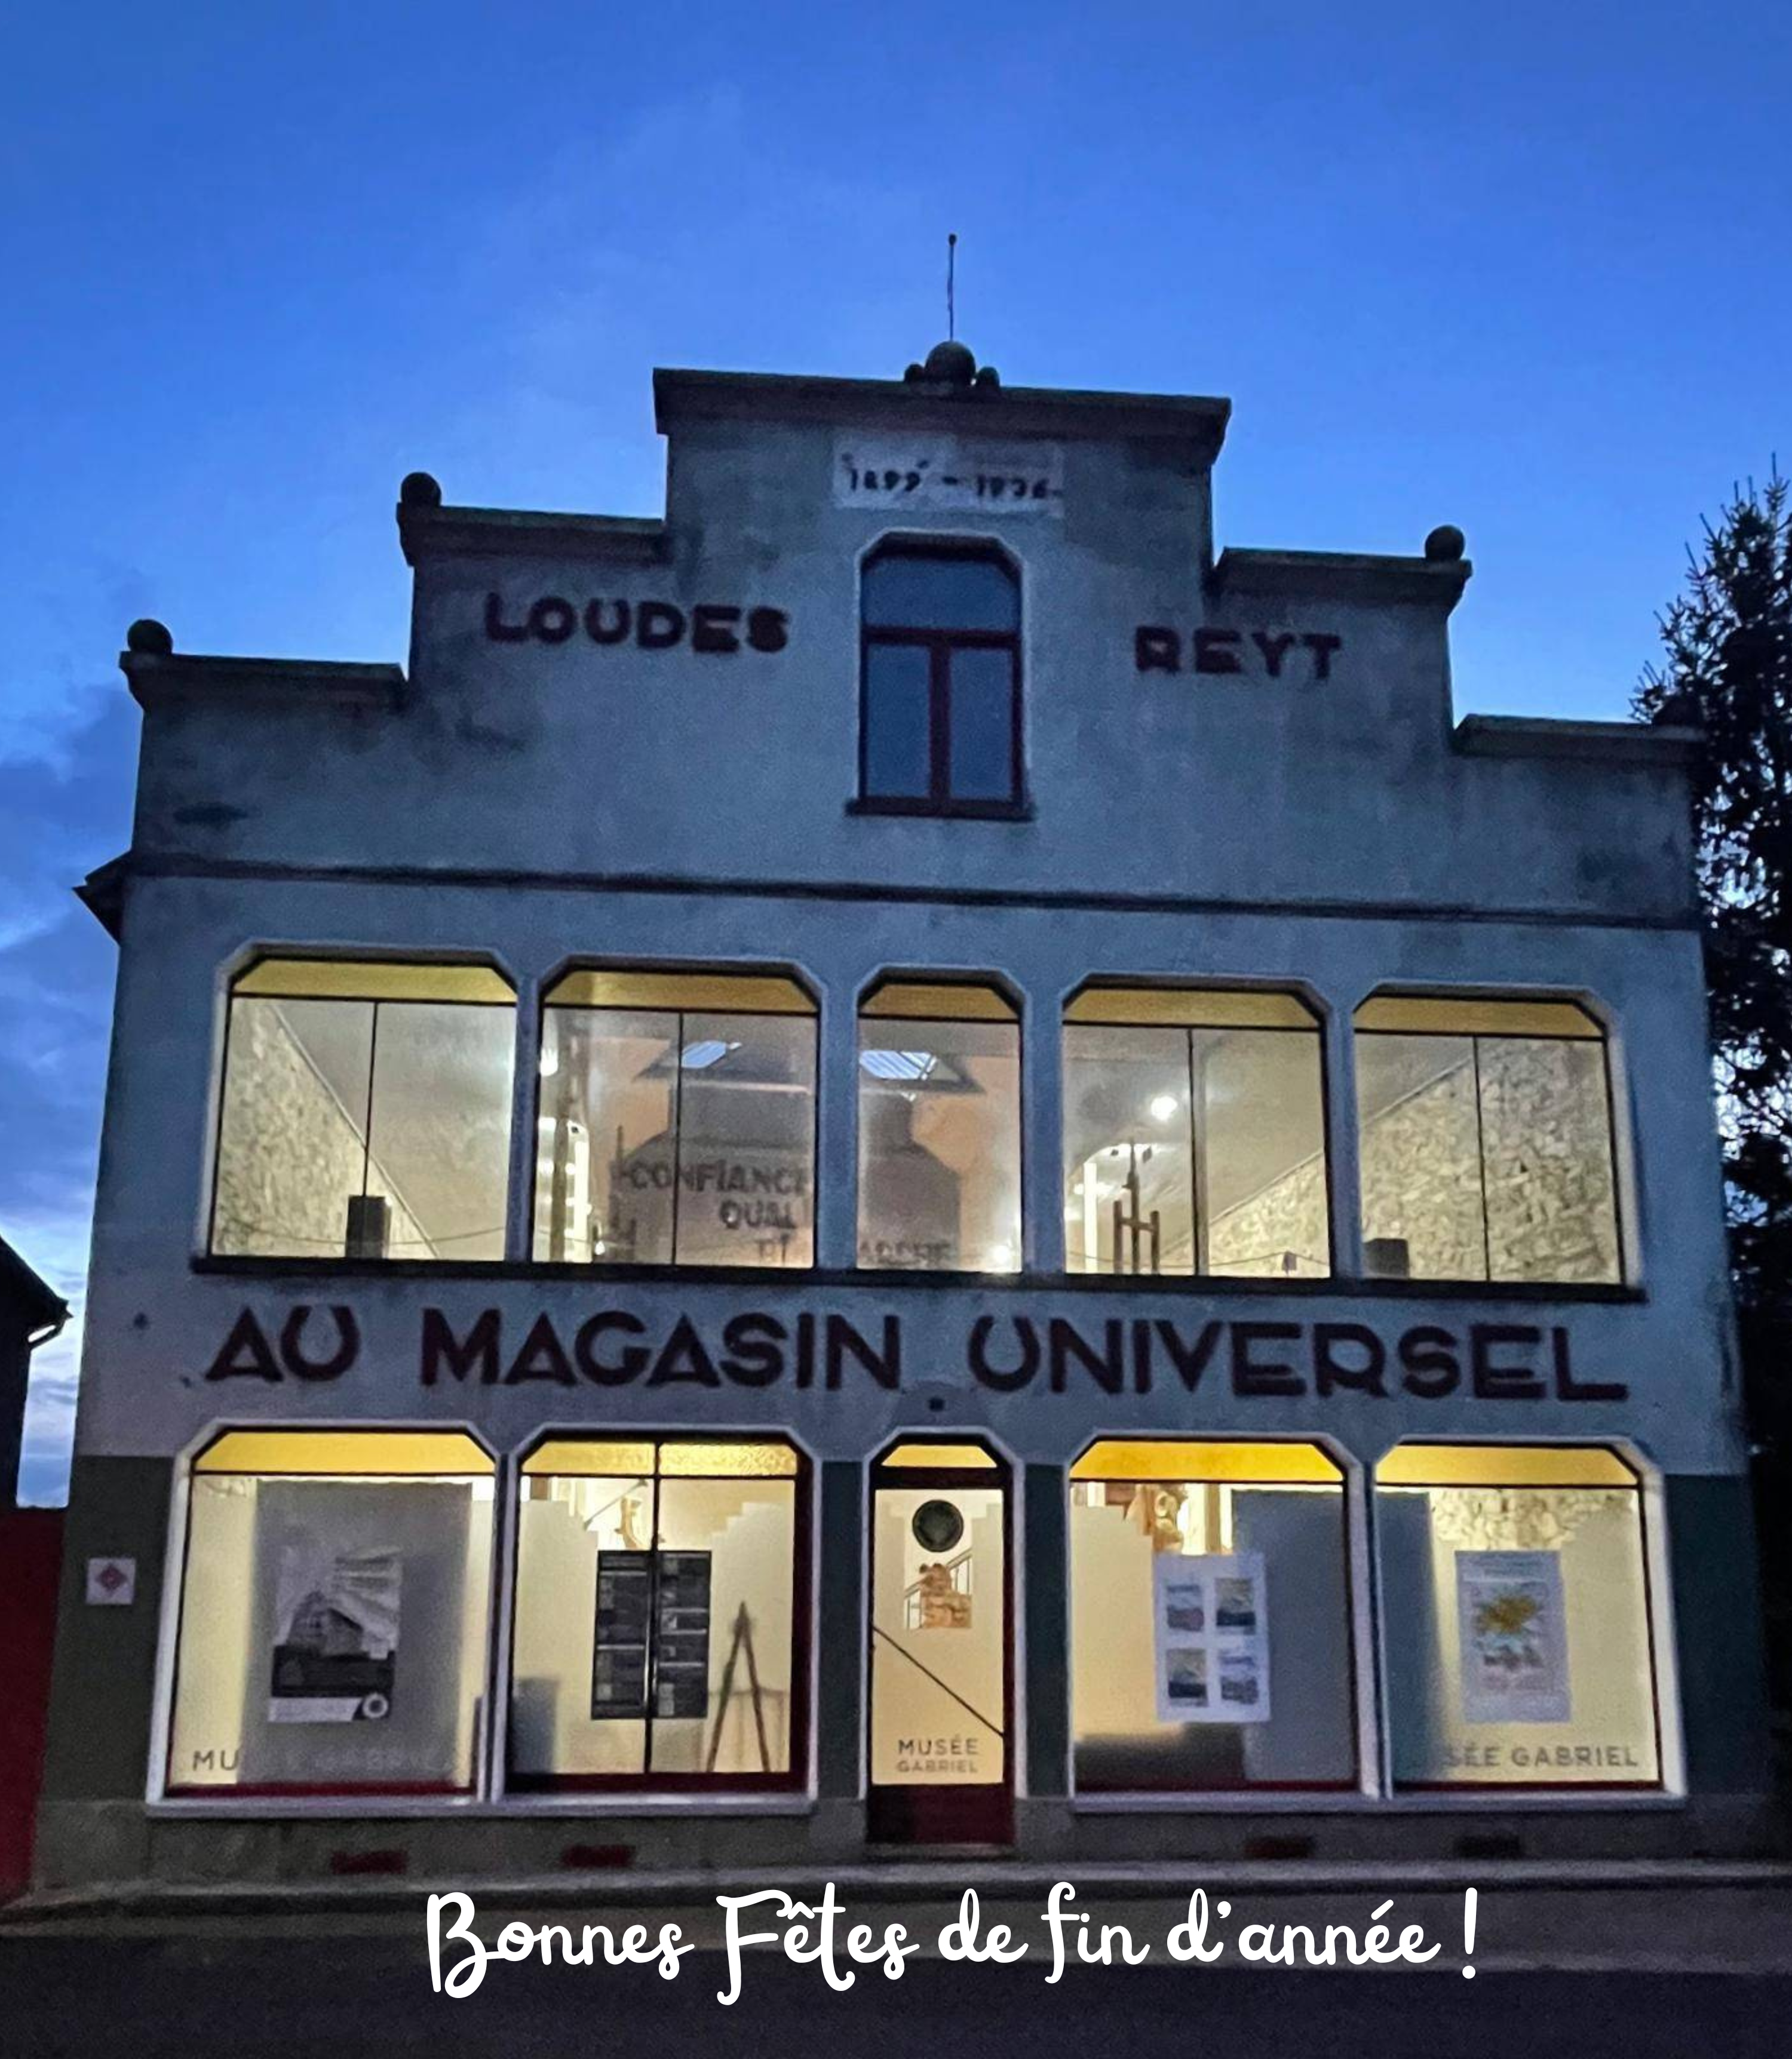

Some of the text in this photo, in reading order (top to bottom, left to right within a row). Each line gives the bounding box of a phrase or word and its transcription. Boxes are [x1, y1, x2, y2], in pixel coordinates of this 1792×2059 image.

[484, 591, 788, 653] LOUDES
[1135, 625, 1342, 680] REYT
[205, 1305, 1629, 1402] AU MAGASIN UNIVERSEL
[898, 1733, 978, 1757] MUSÉE
[1443, 1741, 1638, 1768] SÉE GABRIEL
[897, 1759, 978, 1773] GABRIEL
